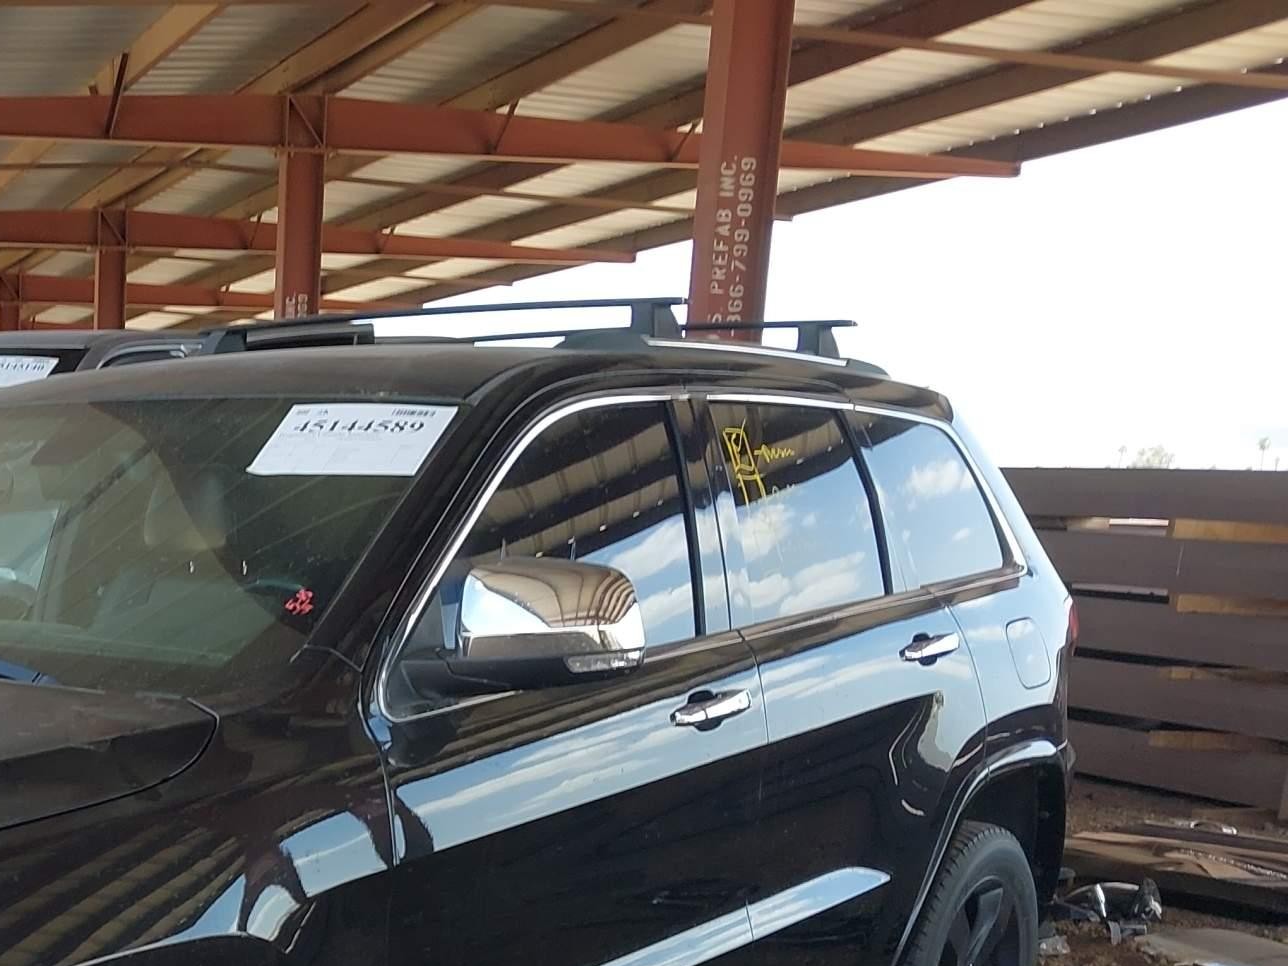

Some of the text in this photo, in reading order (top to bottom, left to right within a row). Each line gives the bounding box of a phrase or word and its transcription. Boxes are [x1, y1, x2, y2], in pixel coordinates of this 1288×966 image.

[719, 154, 738, 197] INC.
[710, 208, 733, 295] PREFAB
[294, 418, 425, 434] 45144589
